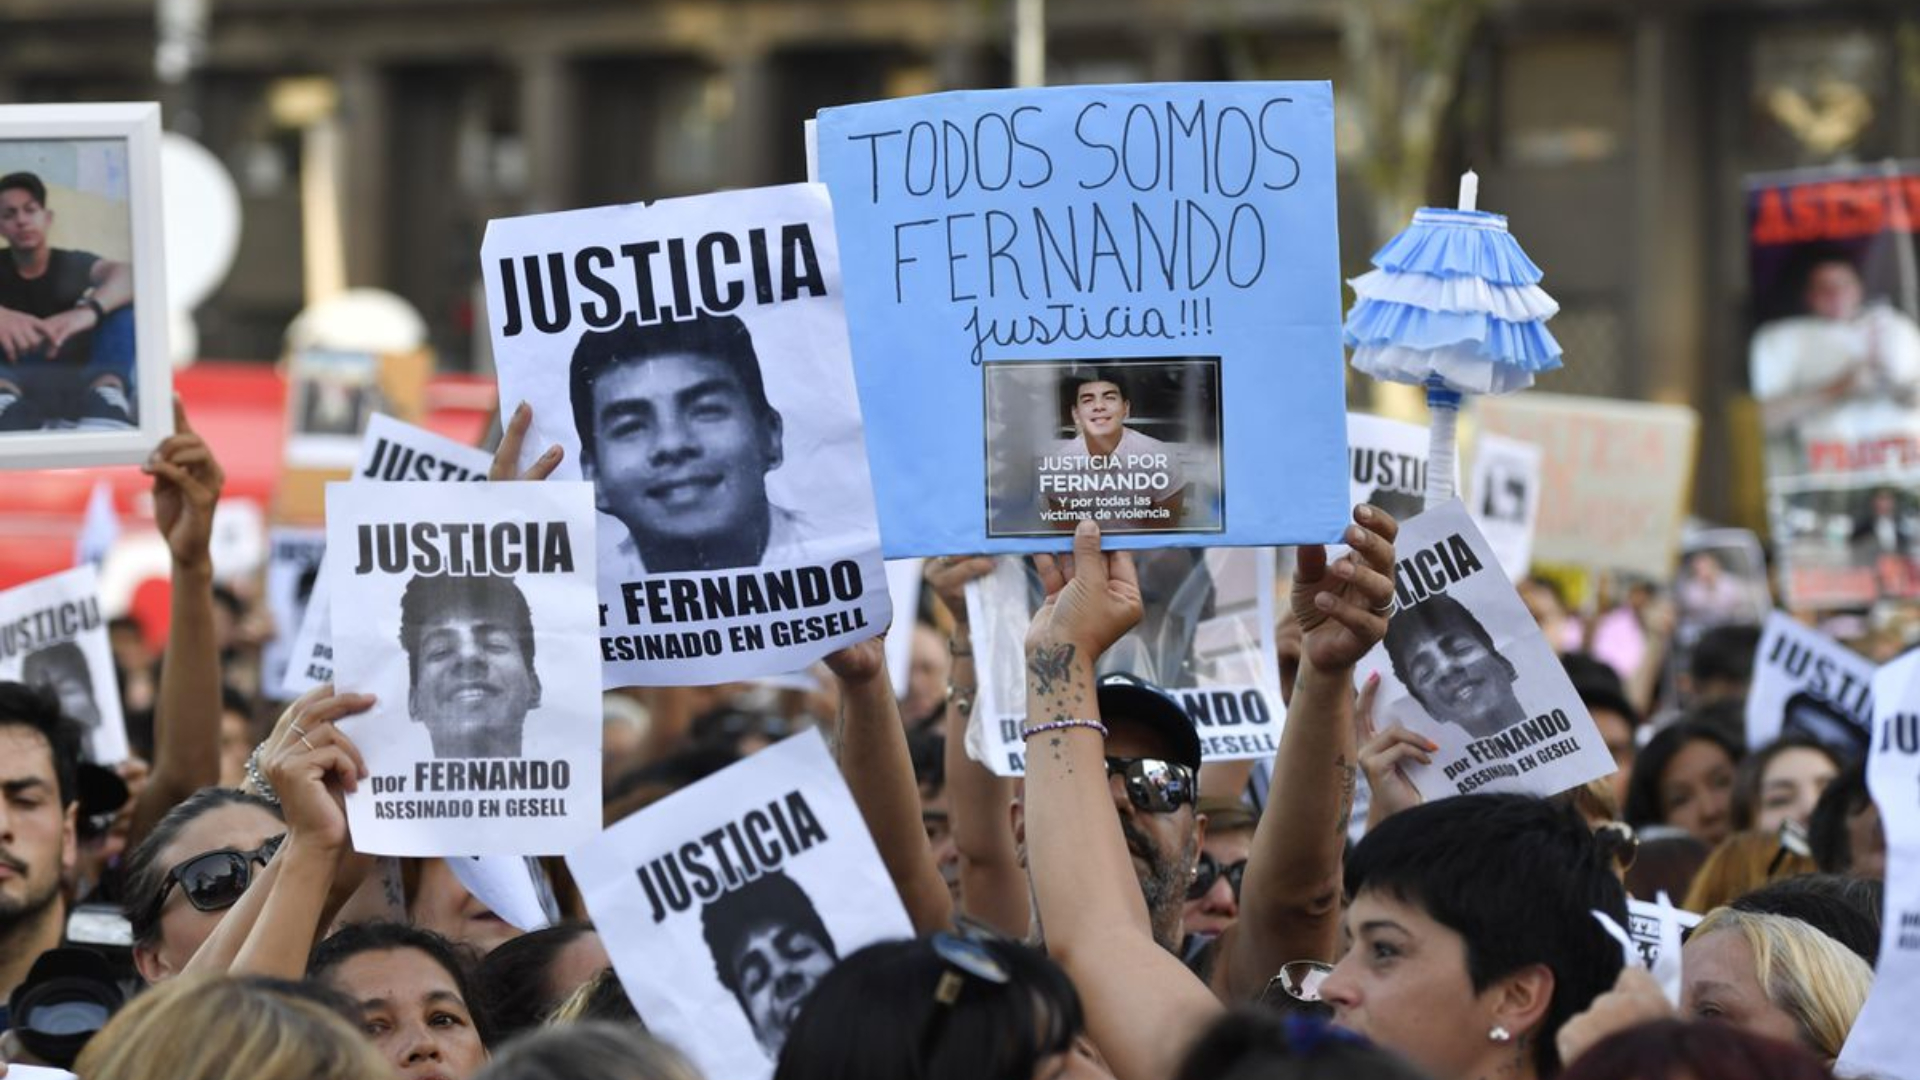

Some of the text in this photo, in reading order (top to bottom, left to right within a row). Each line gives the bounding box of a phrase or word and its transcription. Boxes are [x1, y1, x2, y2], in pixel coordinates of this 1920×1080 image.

[847, 98, 1301, 204] TODOS SOMOS
[893, 199, 1267, 304] FERNANDO
[498, 222, 828, 337] JUSTICIA
[1037, 453, 1168, 471] JUSTICIA POR
[1039, 472, 1169, 493] FERNANDO
[1057, 494, 1152, 509] Y por todas las
[1094, 508, 1112, 520] de
[1114, 506, 1171, 520] violencia
[354, 521, 575, 575] JUSTICIA
[620, 559, 864, 626] FERNANDO
[727, 623, 766, 654] EN
[769, 606, 869, 649] GESELL
[1442, 708, 1572, 782] por FERNANDO
[1517, 753, 1539, 773] EN
[1535, 737, 1582, 765] GESELL
[371, 759, 571, 796] por FERNANDO
[375, 797, 568, 820] ASESINADO EN GESELL
[636, 789, 829, 925] JUSTICIA
